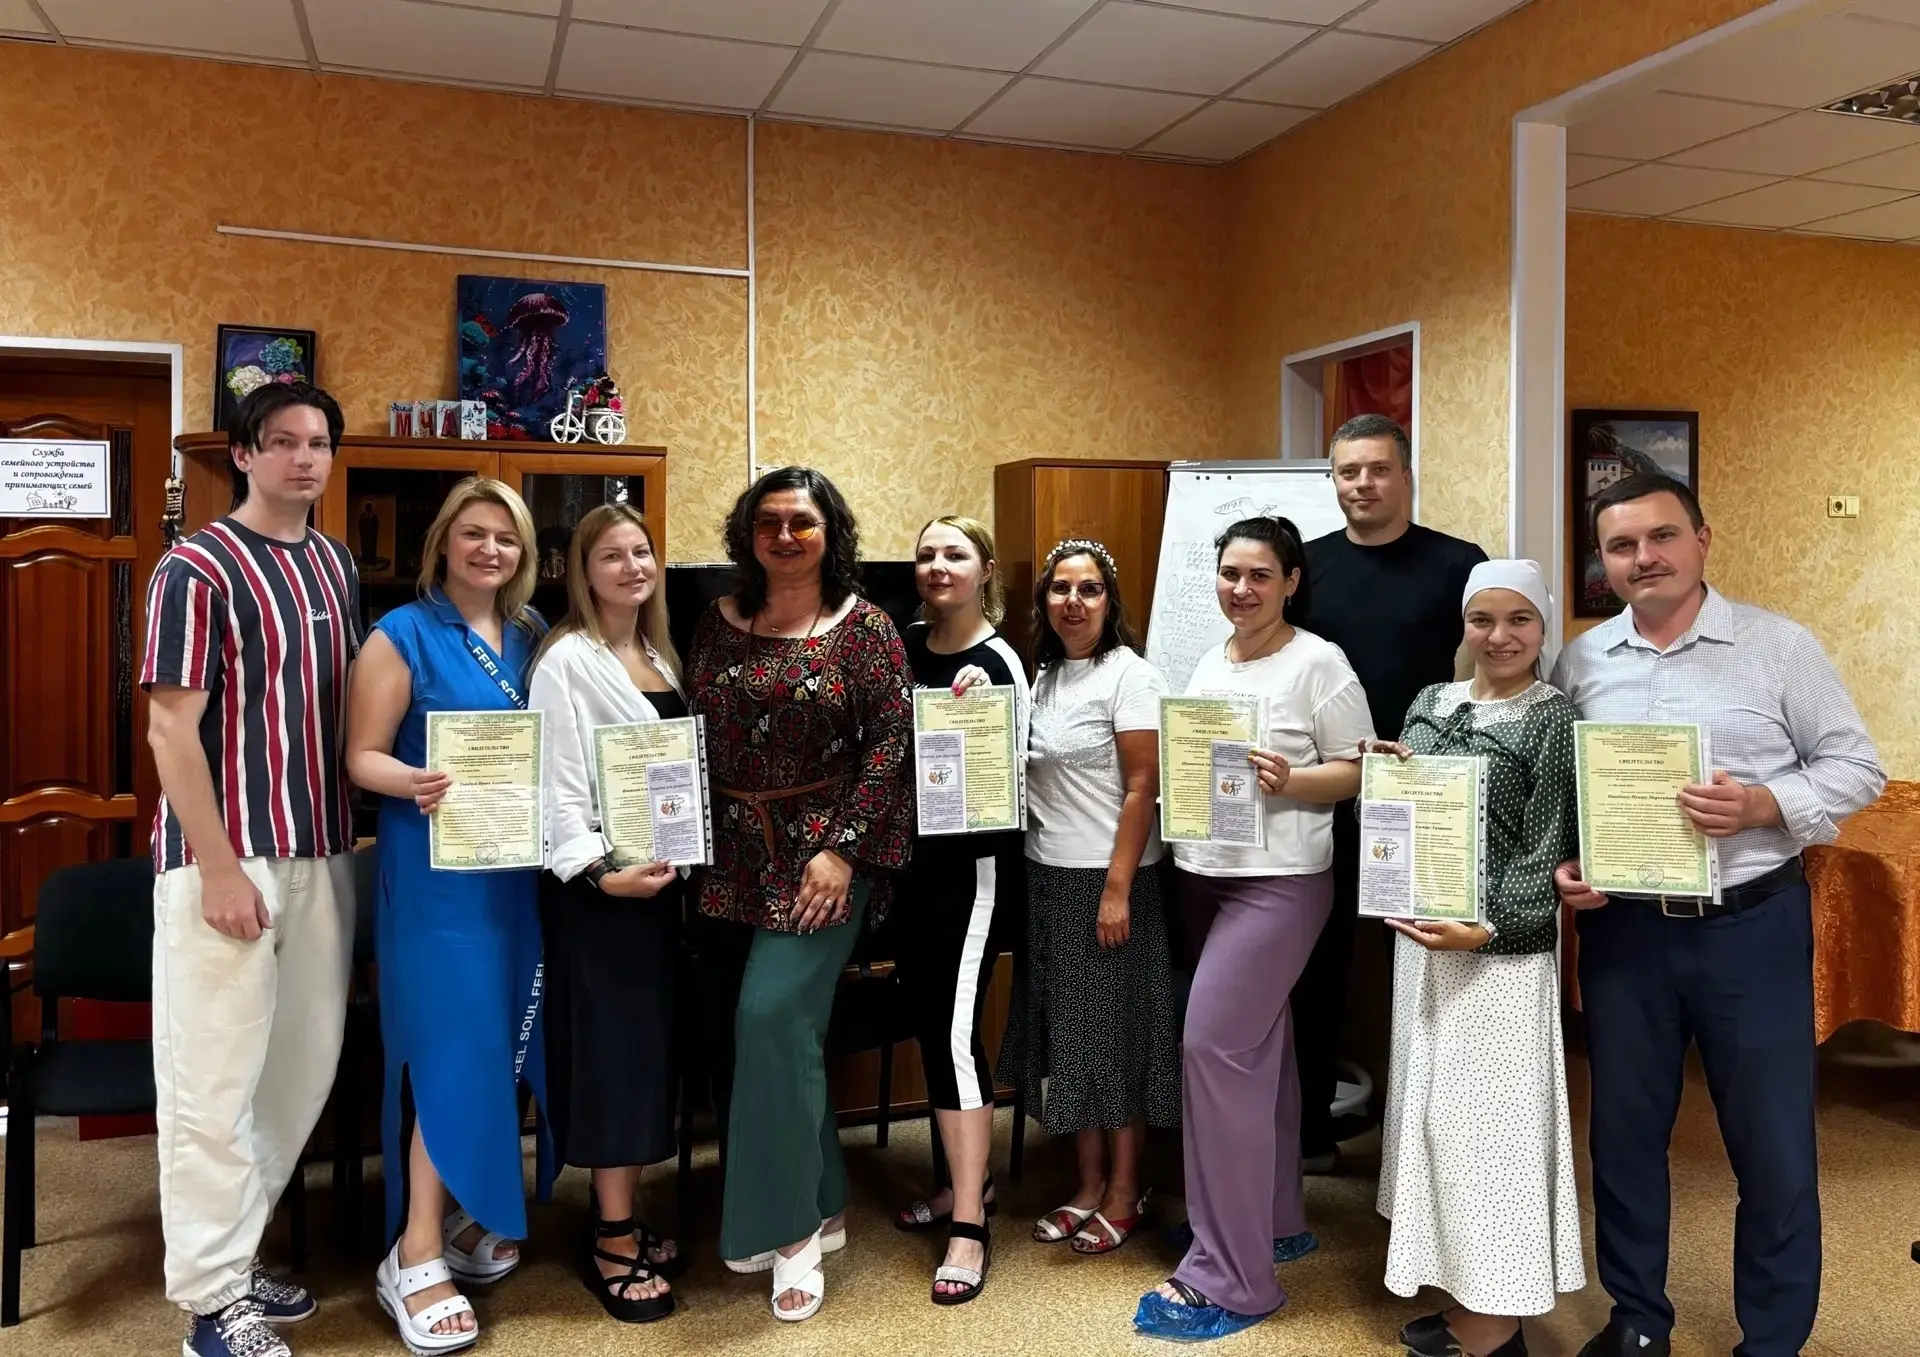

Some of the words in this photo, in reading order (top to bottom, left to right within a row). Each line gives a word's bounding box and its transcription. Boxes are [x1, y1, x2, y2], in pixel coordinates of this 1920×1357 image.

[32, 448, 65, 458] Служба
[1, 460, 44, 468] семейного
[45, 460, 96, 469] устройства
[21, 471, 84, 479] сопровождения
[5, 481, 67, 490] принимающих
[520, 1000, 539, 1041] SOUL
